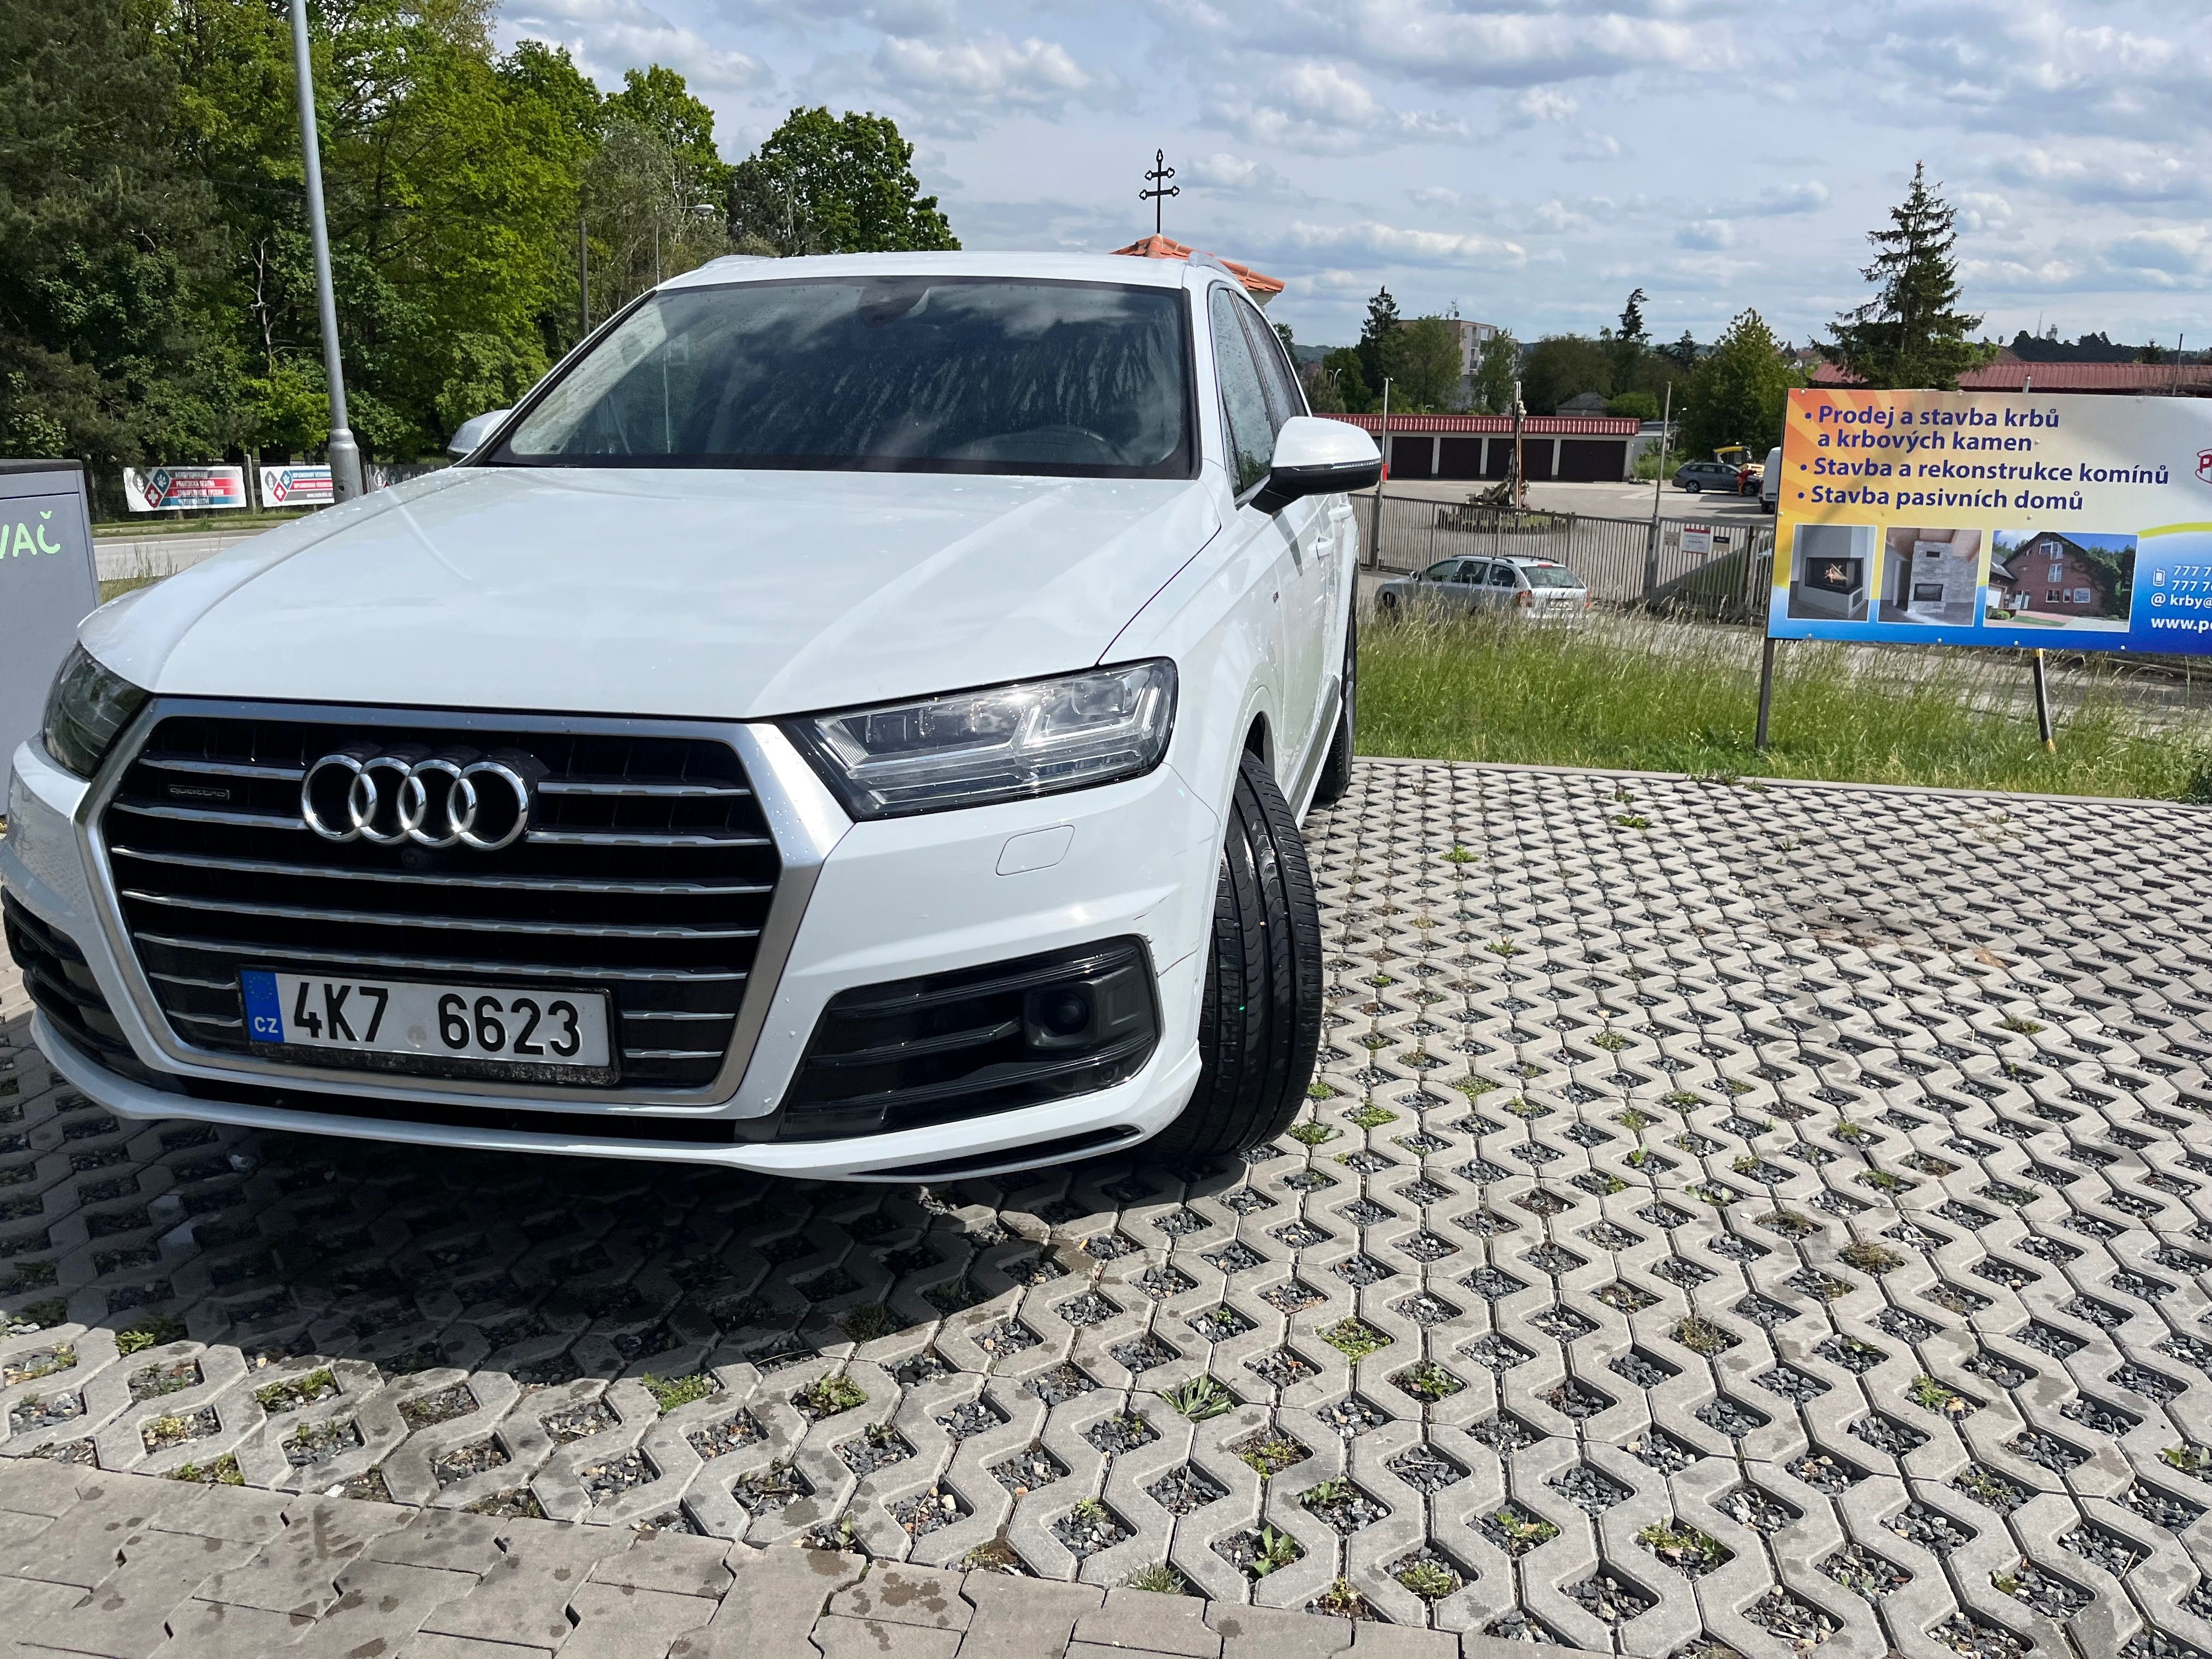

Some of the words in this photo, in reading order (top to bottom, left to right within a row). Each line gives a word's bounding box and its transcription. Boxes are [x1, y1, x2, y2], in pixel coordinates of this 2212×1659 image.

[1819, 405, 1895, 430] Prodej
[1900, 410, 1914, 425] a
[1919, 407, 1997, 427] stavba
[2004, 408, 2059, 428] krbů
[1817, 433, 1830, 447] a
[1837, 428, 1945, 454] krbových
[1952, 431, 2032, 452] kamen
[1813, 457, 1892, 477] Stavba
[1898, 464, 1911, 477] a
[1918, 459, 2073, 482] rekonstrukce
[2079, 462, 2169, 484] komínů
[1810, 485, 1889, 505] Stavba
[1895, 488, 2007, 510] pasivních
[2013, 490, 2083, 511] domů
[2174, 565, 2199, 576] 777
[2172, 580, 2198, 591] 777
[2202, 581, 2212, 592] 7
[2151, 618, 2212, 634] www.p
[254, 1016, 279, 1034] CZ
[294, 981, 389, 1042] 4K7
[438, 993, 582, 1057] 6623
